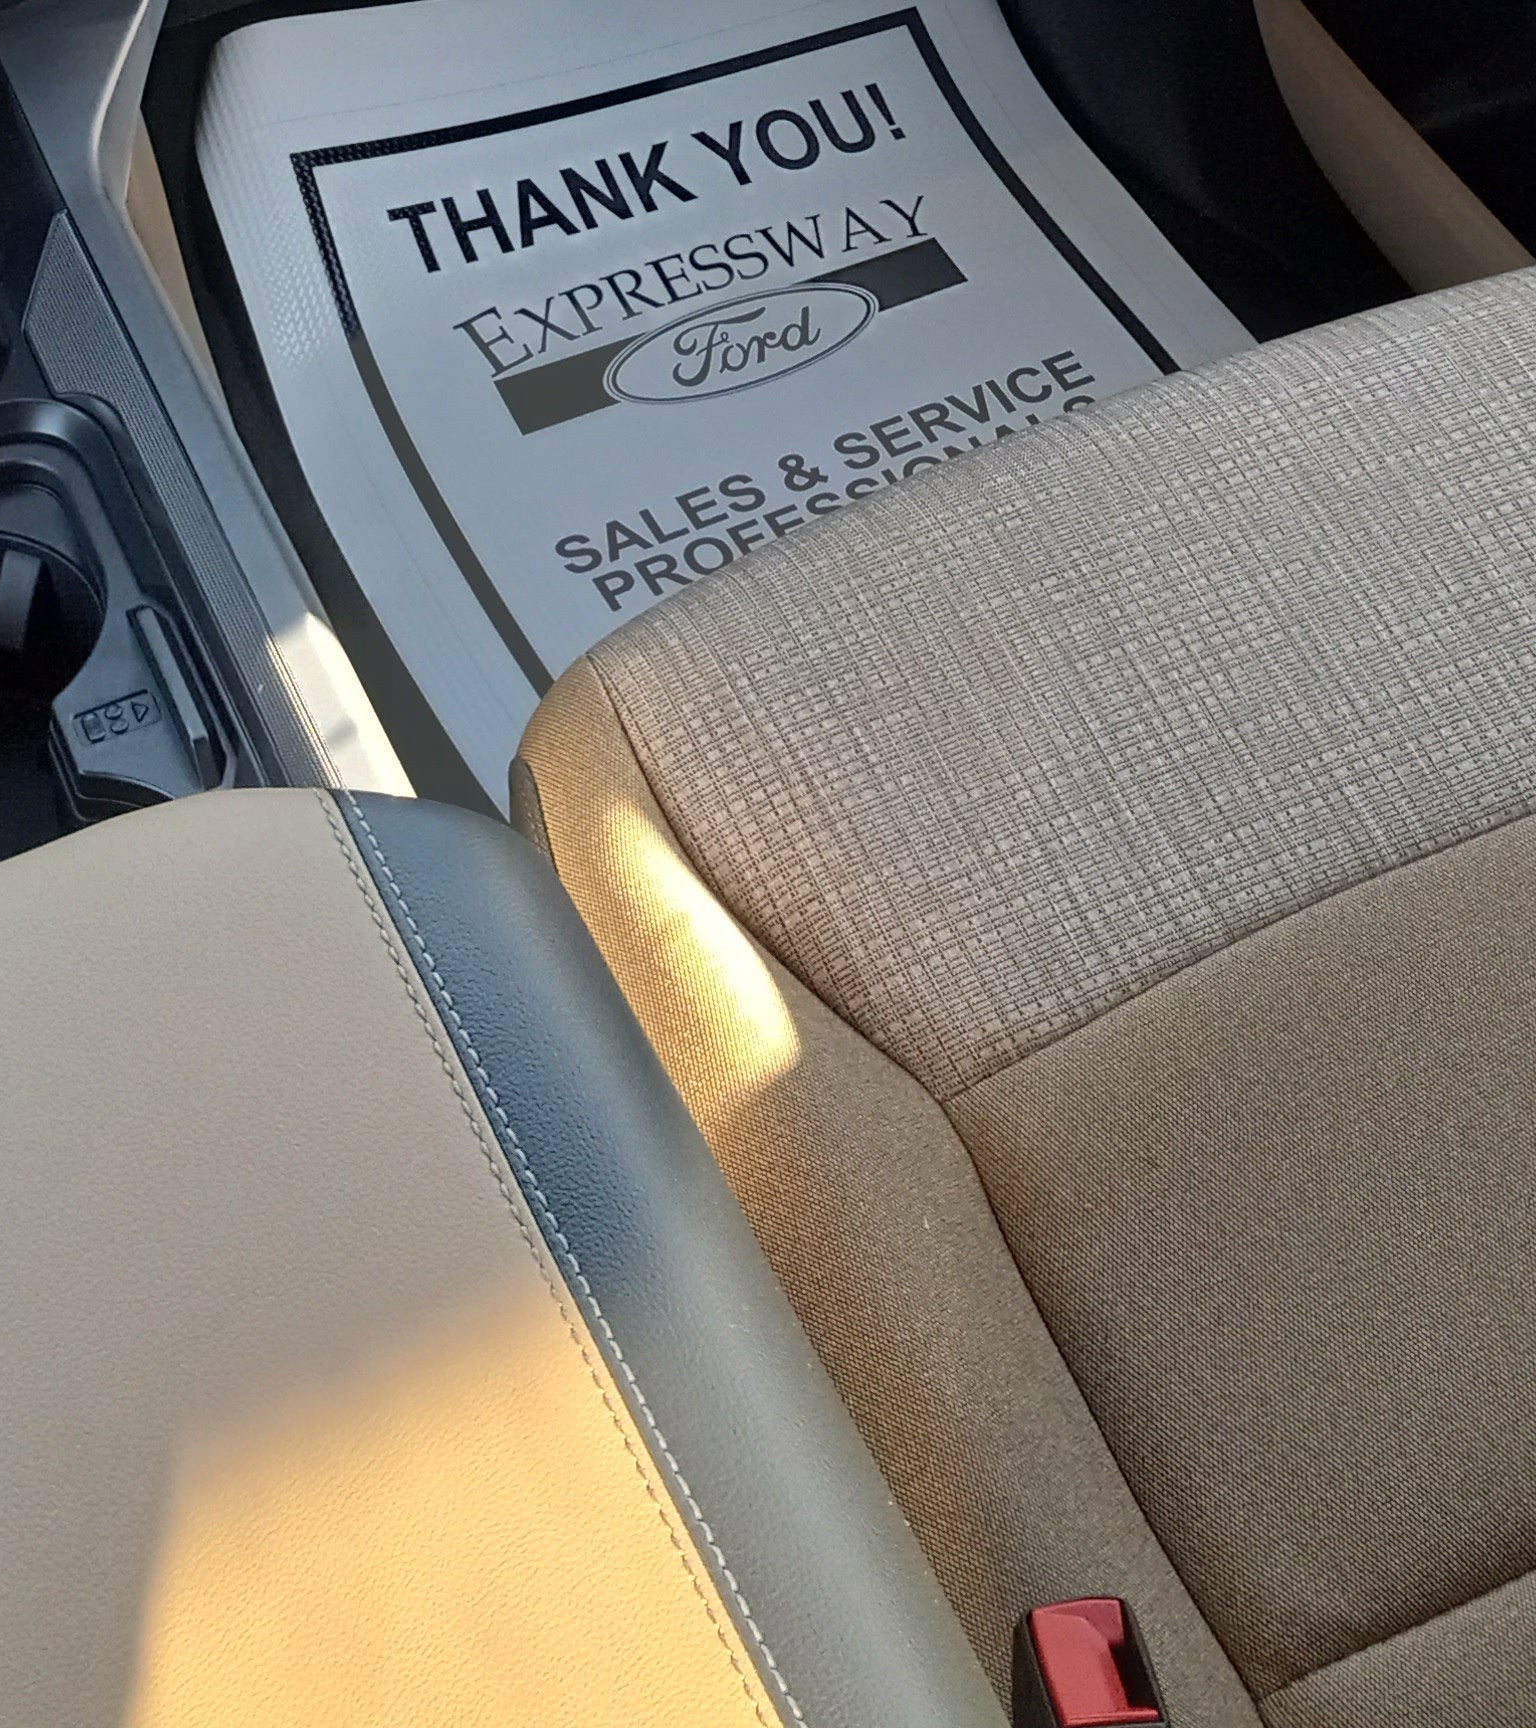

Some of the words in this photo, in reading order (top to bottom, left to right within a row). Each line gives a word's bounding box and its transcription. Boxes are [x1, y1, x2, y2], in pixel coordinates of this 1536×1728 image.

[386, 140, 699, 274] THANK
[690, 82, 907, 187] YOU!
[452, 195, 929, 378] EXPRESSWAY
[671, 305, 822, 387] Ford
[553, 473, 766, 574] SALES
[777, 453, 830, 493] &
[832, 349, 1098, 471] SERVICE
